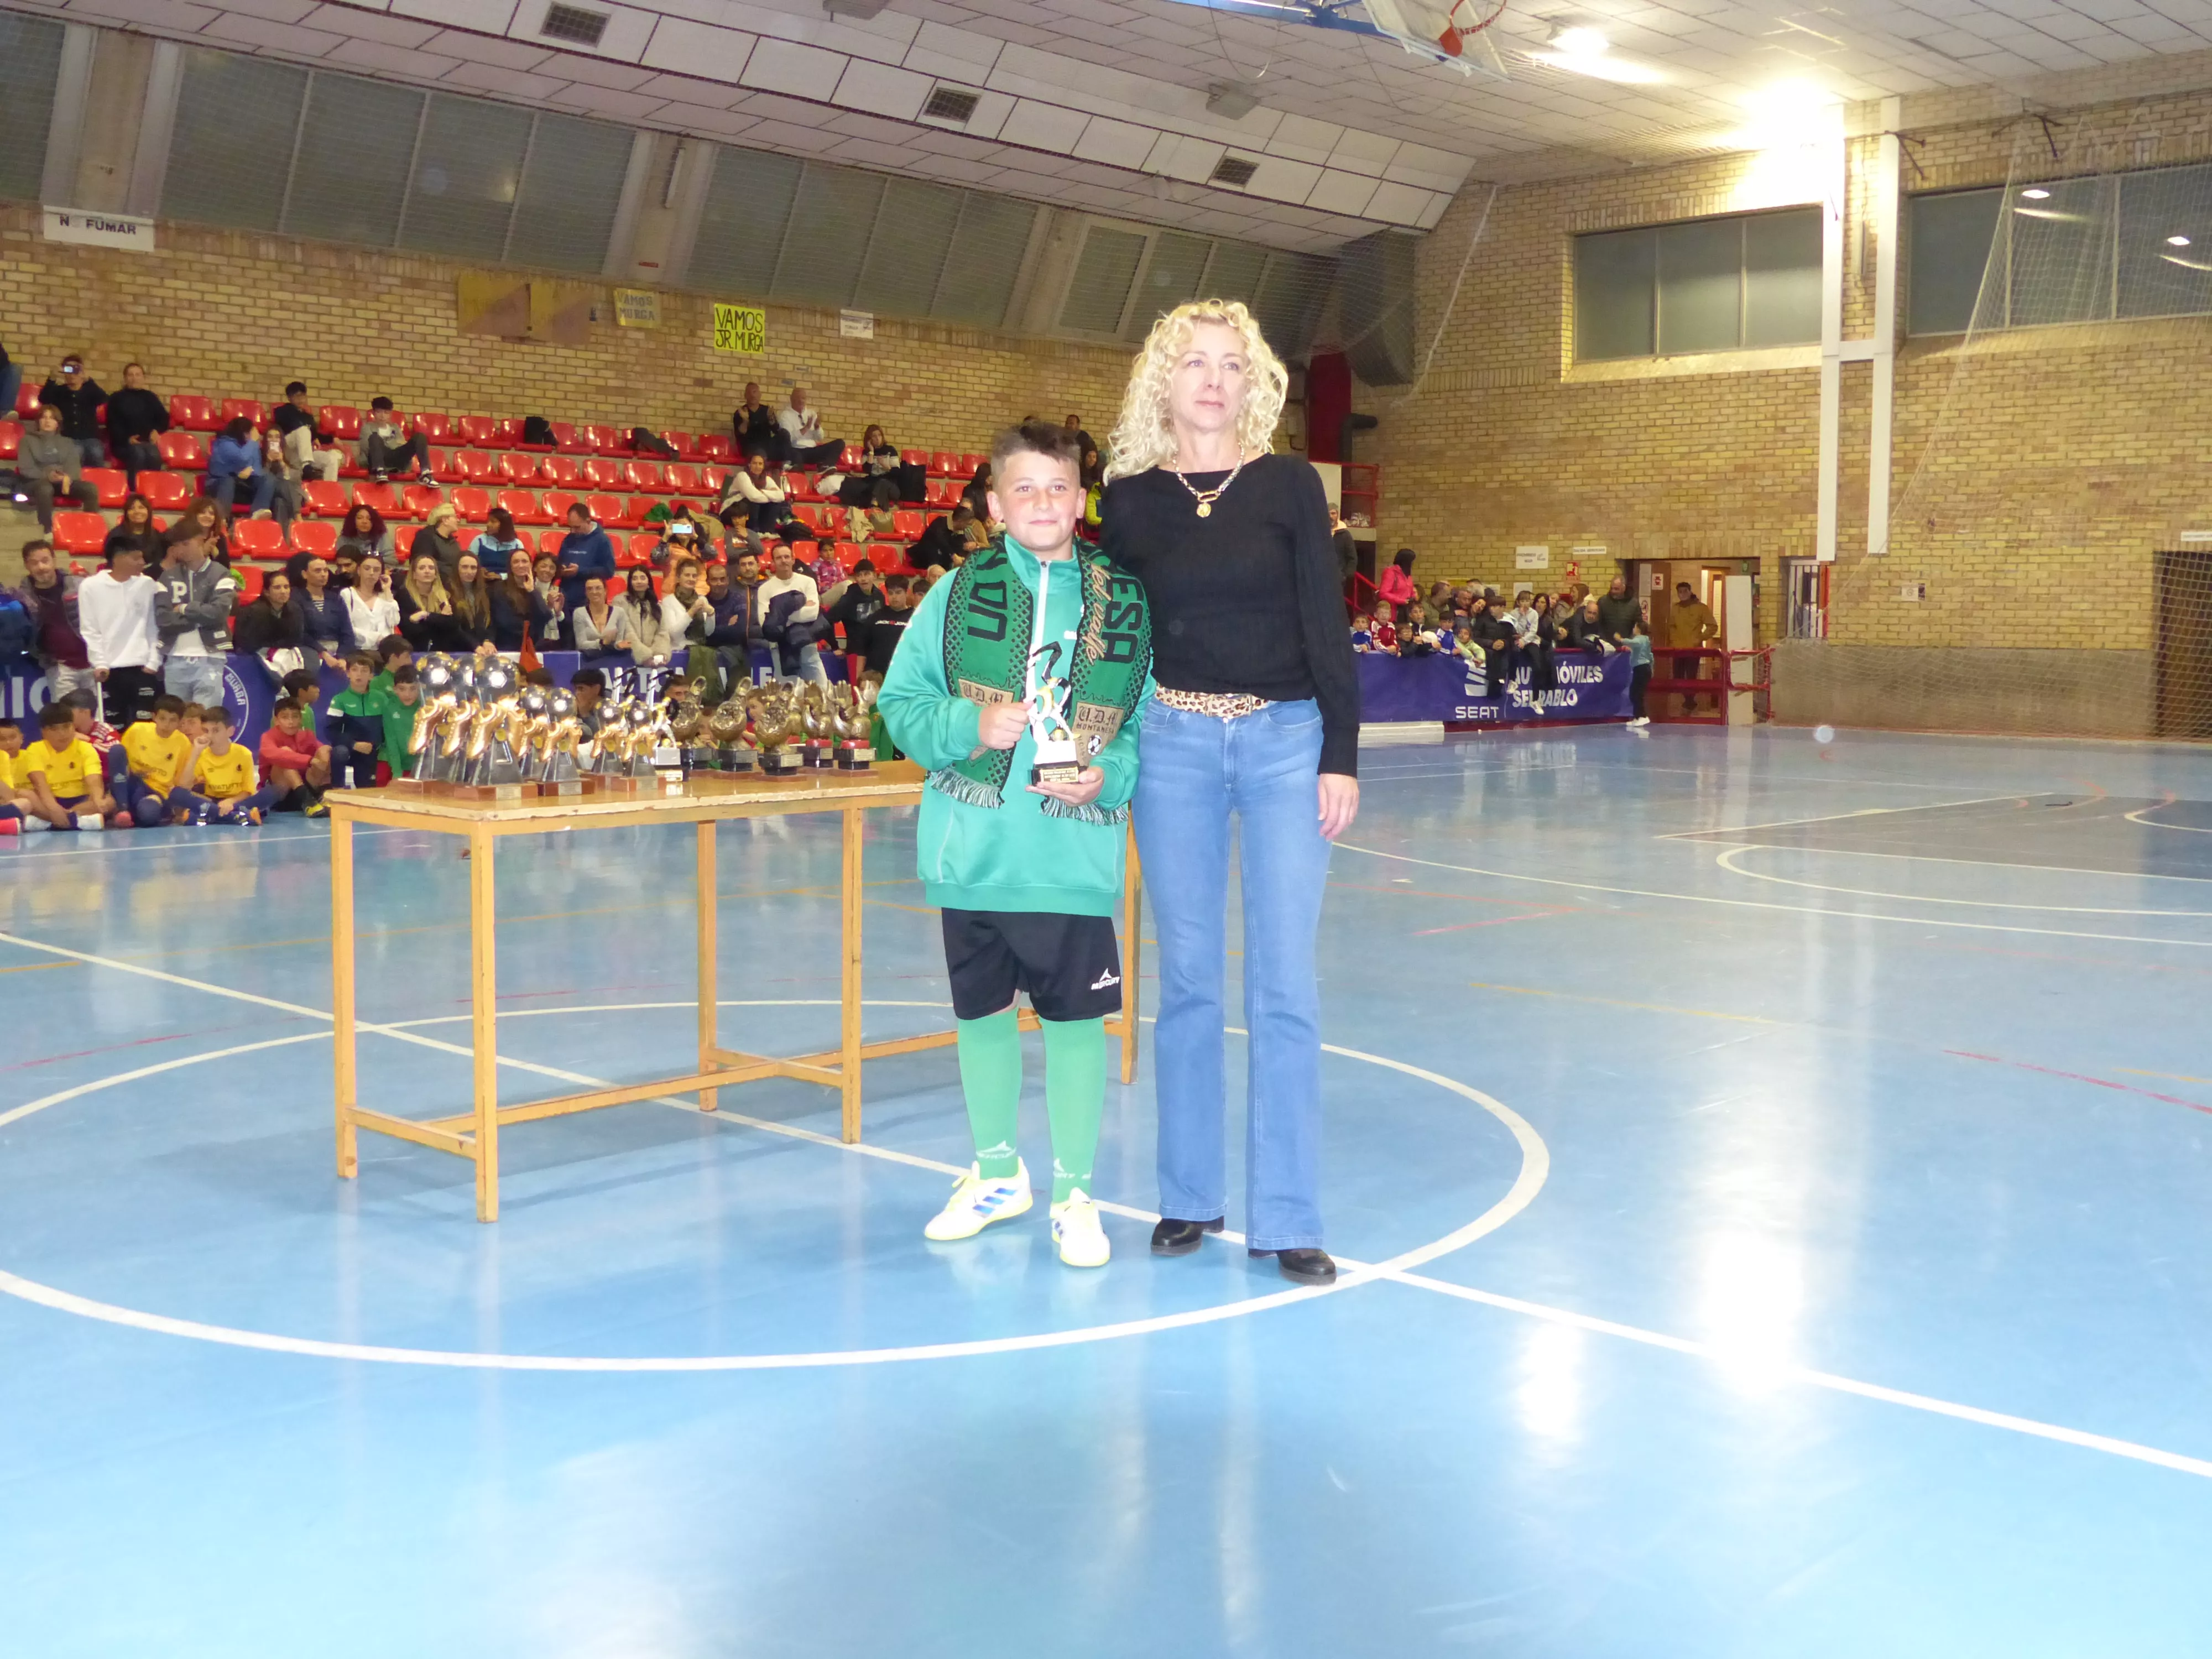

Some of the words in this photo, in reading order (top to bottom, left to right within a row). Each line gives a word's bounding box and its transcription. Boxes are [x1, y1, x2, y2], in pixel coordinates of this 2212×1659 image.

[86, 219, 136, 235] FUMAR
[618, 291, 653, 306] VAMOS
[619, 307, 655, 321] MURGA
[716, 307, 763, 333] VAMOS
[716, 329, 734, 349] JR.
[734, 331, 764, 352] MURGA
[170, 581, 187, 603] P
[1515, 661, 1604, 686] AUÓVILES
[1455, 706, 1499, 719] SEAT
